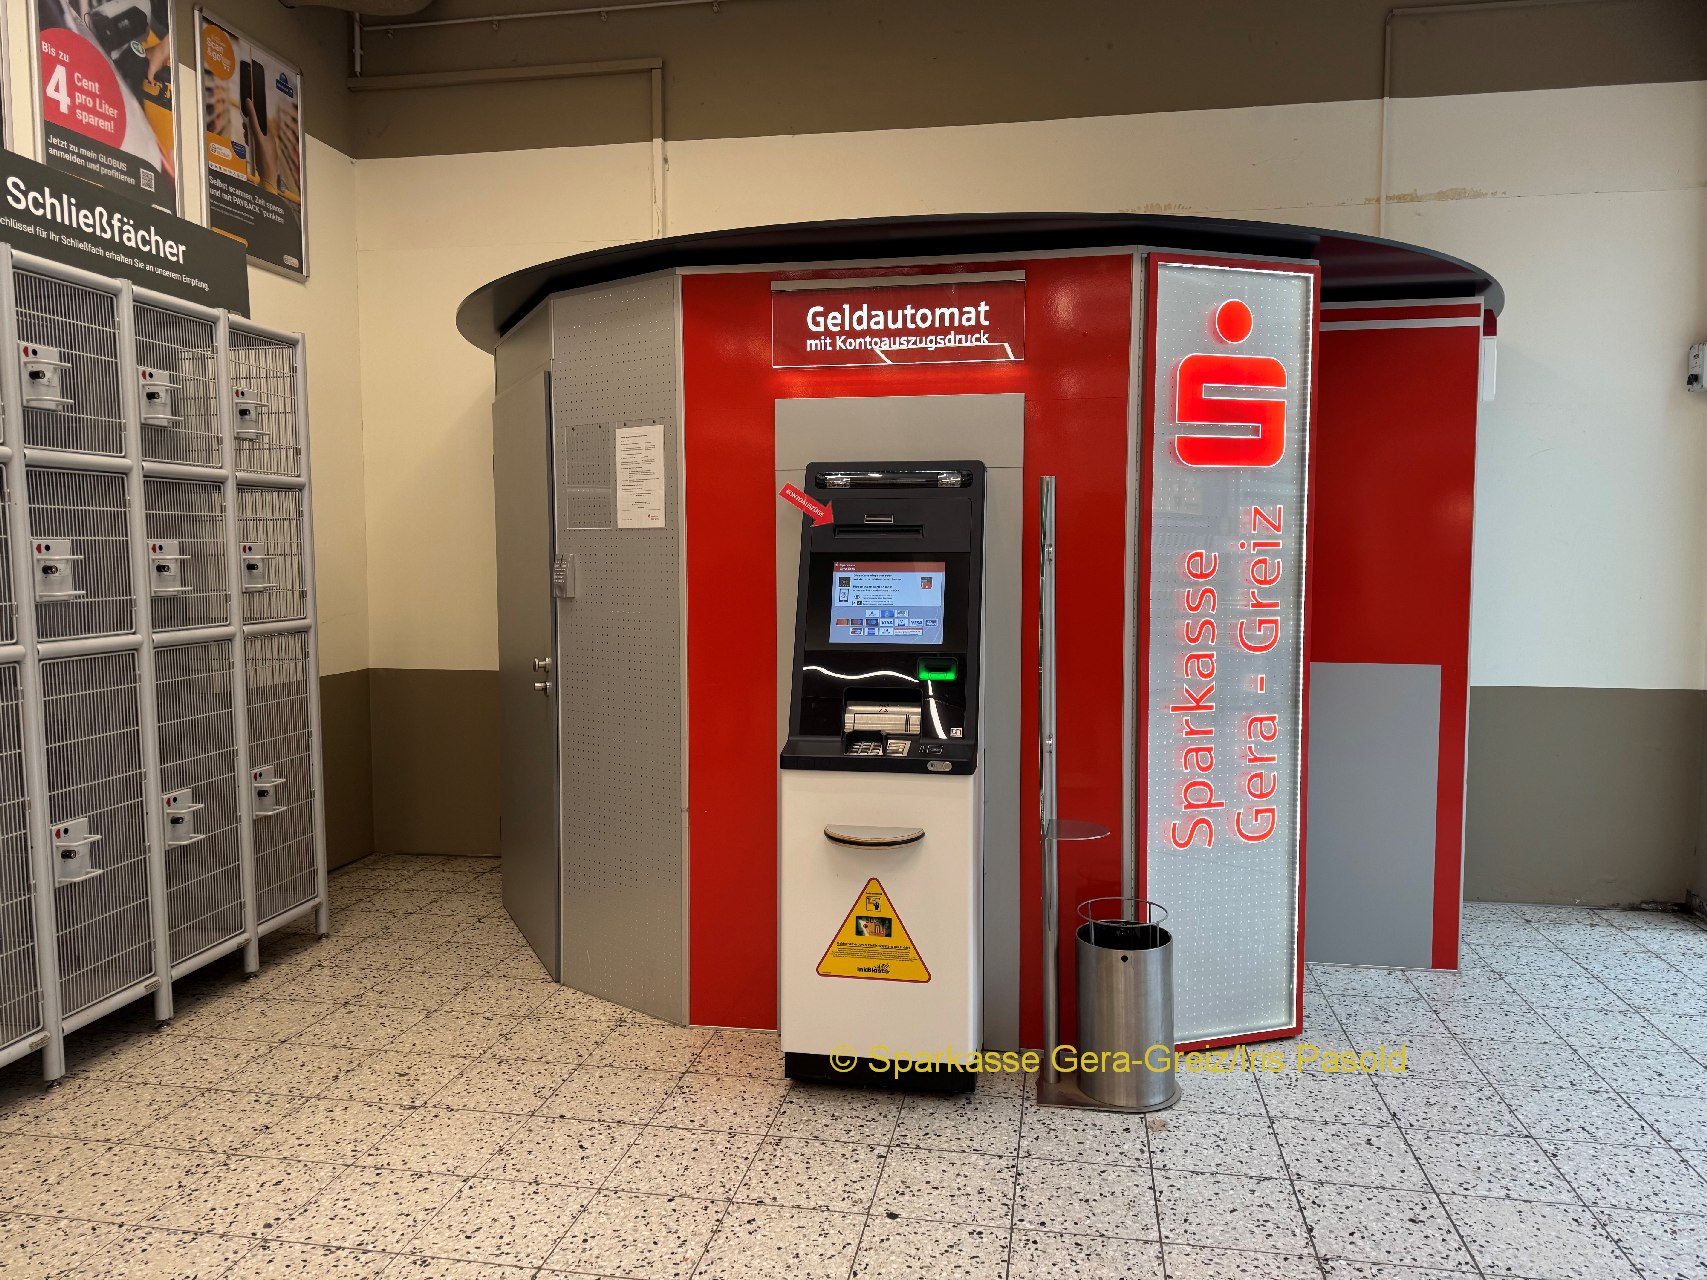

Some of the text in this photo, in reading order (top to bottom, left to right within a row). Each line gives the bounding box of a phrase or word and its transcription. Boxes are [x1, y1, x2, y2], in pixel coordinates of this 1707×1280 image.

[41, 40, 70, 63] Bis zu
[46, 64, 71, 114] 4
[74, 72, 100, 95] Cent
[75, 91, 118, 119] pro Liter
[76, 108, 115, 133] sparen!
[48, 134, 128, 171] Jetzt zu mein GLOBUS
[48, 147, 136, 186] anmelden und profitieren
[208, 175, 228, 190] Selbst
[209, 187, 221, 198] und
[232, 195, 261, 214] PAYBACK
[6, 176, 187, 265] Schließfächer
[0, 216, 34, 235] chlüssel
[36, 226, 48, 239] für
[49, 231, 60, 243] Ihr
[61, 235, 104, 256] Schließfach
[105, 248, 133, 266] erhalten
[133, 258, 145, 269] Sie
[145, 263, 154, 272] an
[154, 266, 182, 281] unserem
[806, 301, 990, 332] Geldautomat
[806, 330, 990, 351] mit Kontoauszugsdruck
[1238, 504, 1283, 654] Greiz
[1169, 549, 1225, 850] Sparkasse
[1235, 713, 1279, 844] Gera
